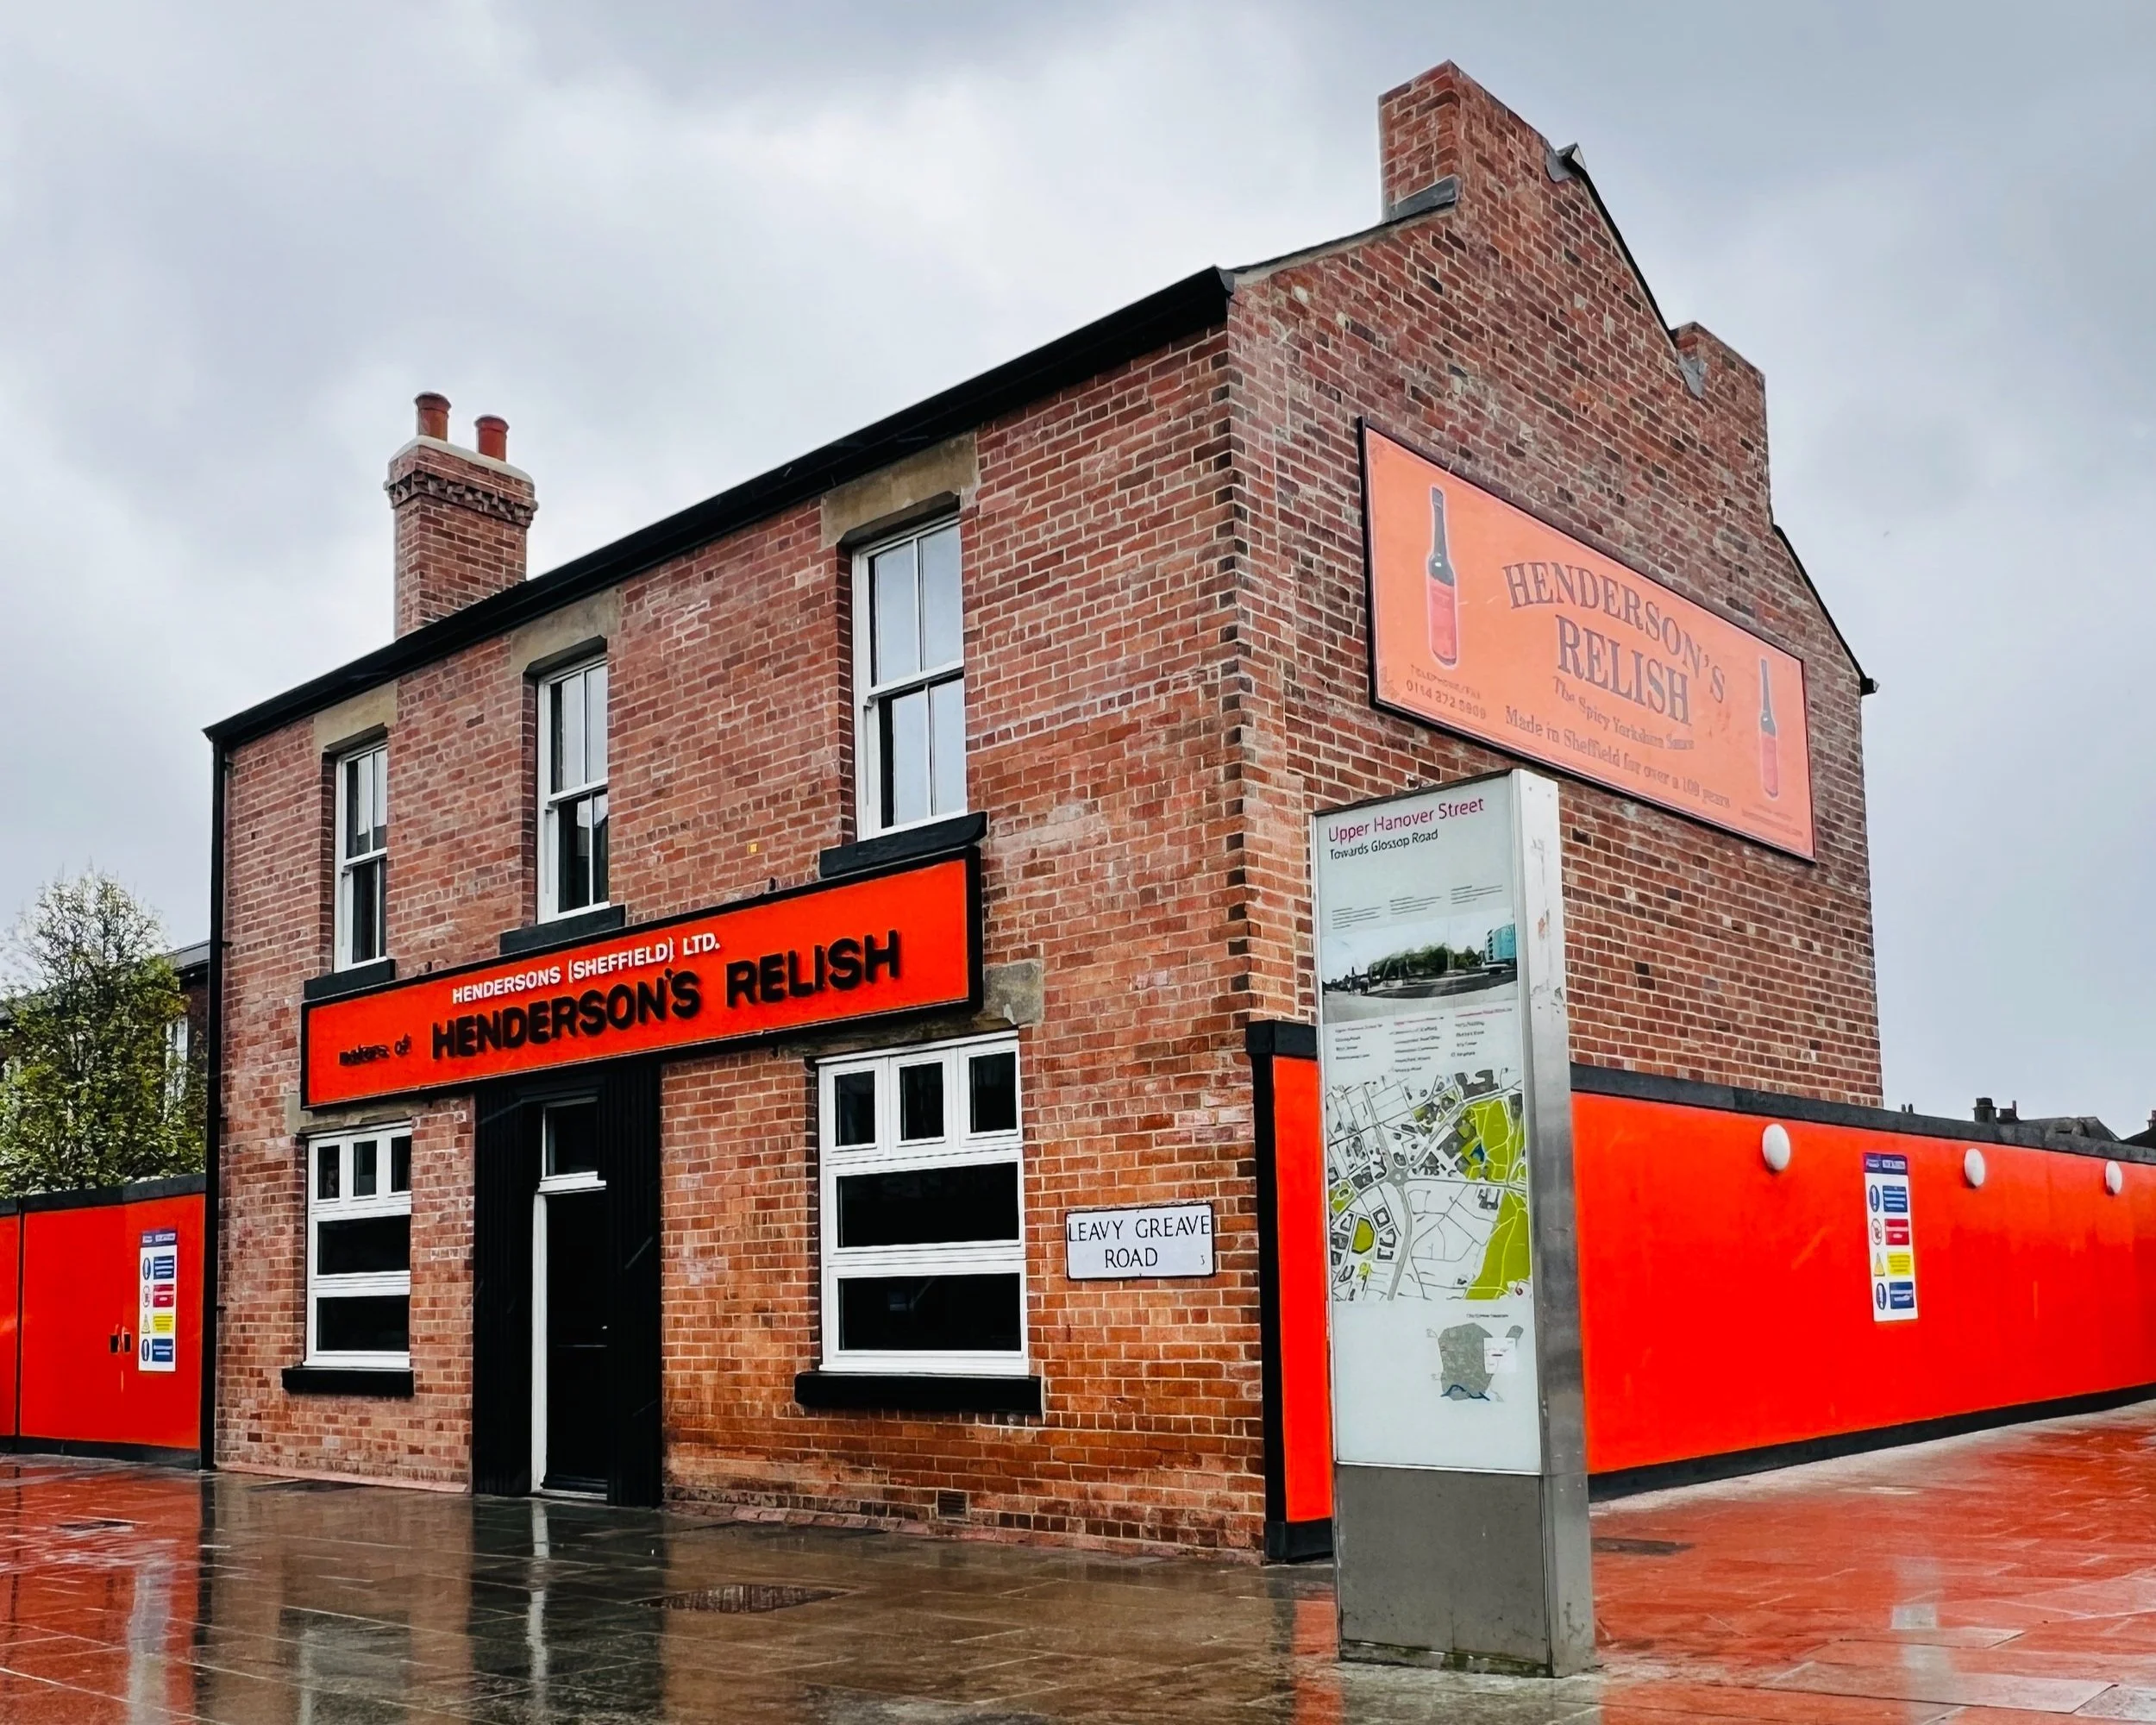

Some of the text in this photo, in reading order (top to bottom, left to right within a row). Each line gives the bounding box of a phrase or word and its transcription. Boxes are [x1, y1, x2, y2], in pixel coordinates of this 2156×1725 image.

[1501, 561, 1726, 704] HENDERSON'S
[1555, 614, 1692, 727] RELISH
[1552, 675, 1576, 705] The
[1578, 696, 1611, 731] Spicy
[1505, 704, 1544, 737] Made
[1546, 721, 1560, 743] in
[1564, 729, 1620, 768] Sheffield
[1643, 766, 1670, 785] over
[1328, 798, 1485, 845] Upper Hanover Street
[1330, 828, 1439, 861] Towards Glossop Road
[393, 1032, 412, 1058] of
[431, 967, 703, 1061] HENDERSON'S
[725, 929, 901, 1009] RELISH
[452, 932, 721, 1005] HENDERSONS (SHEFFIELD) LTD.
[1068, 1214, 1211, 1242] LEAVY GREAVE
[1105, 1247, 1158, 1269] ROAD
